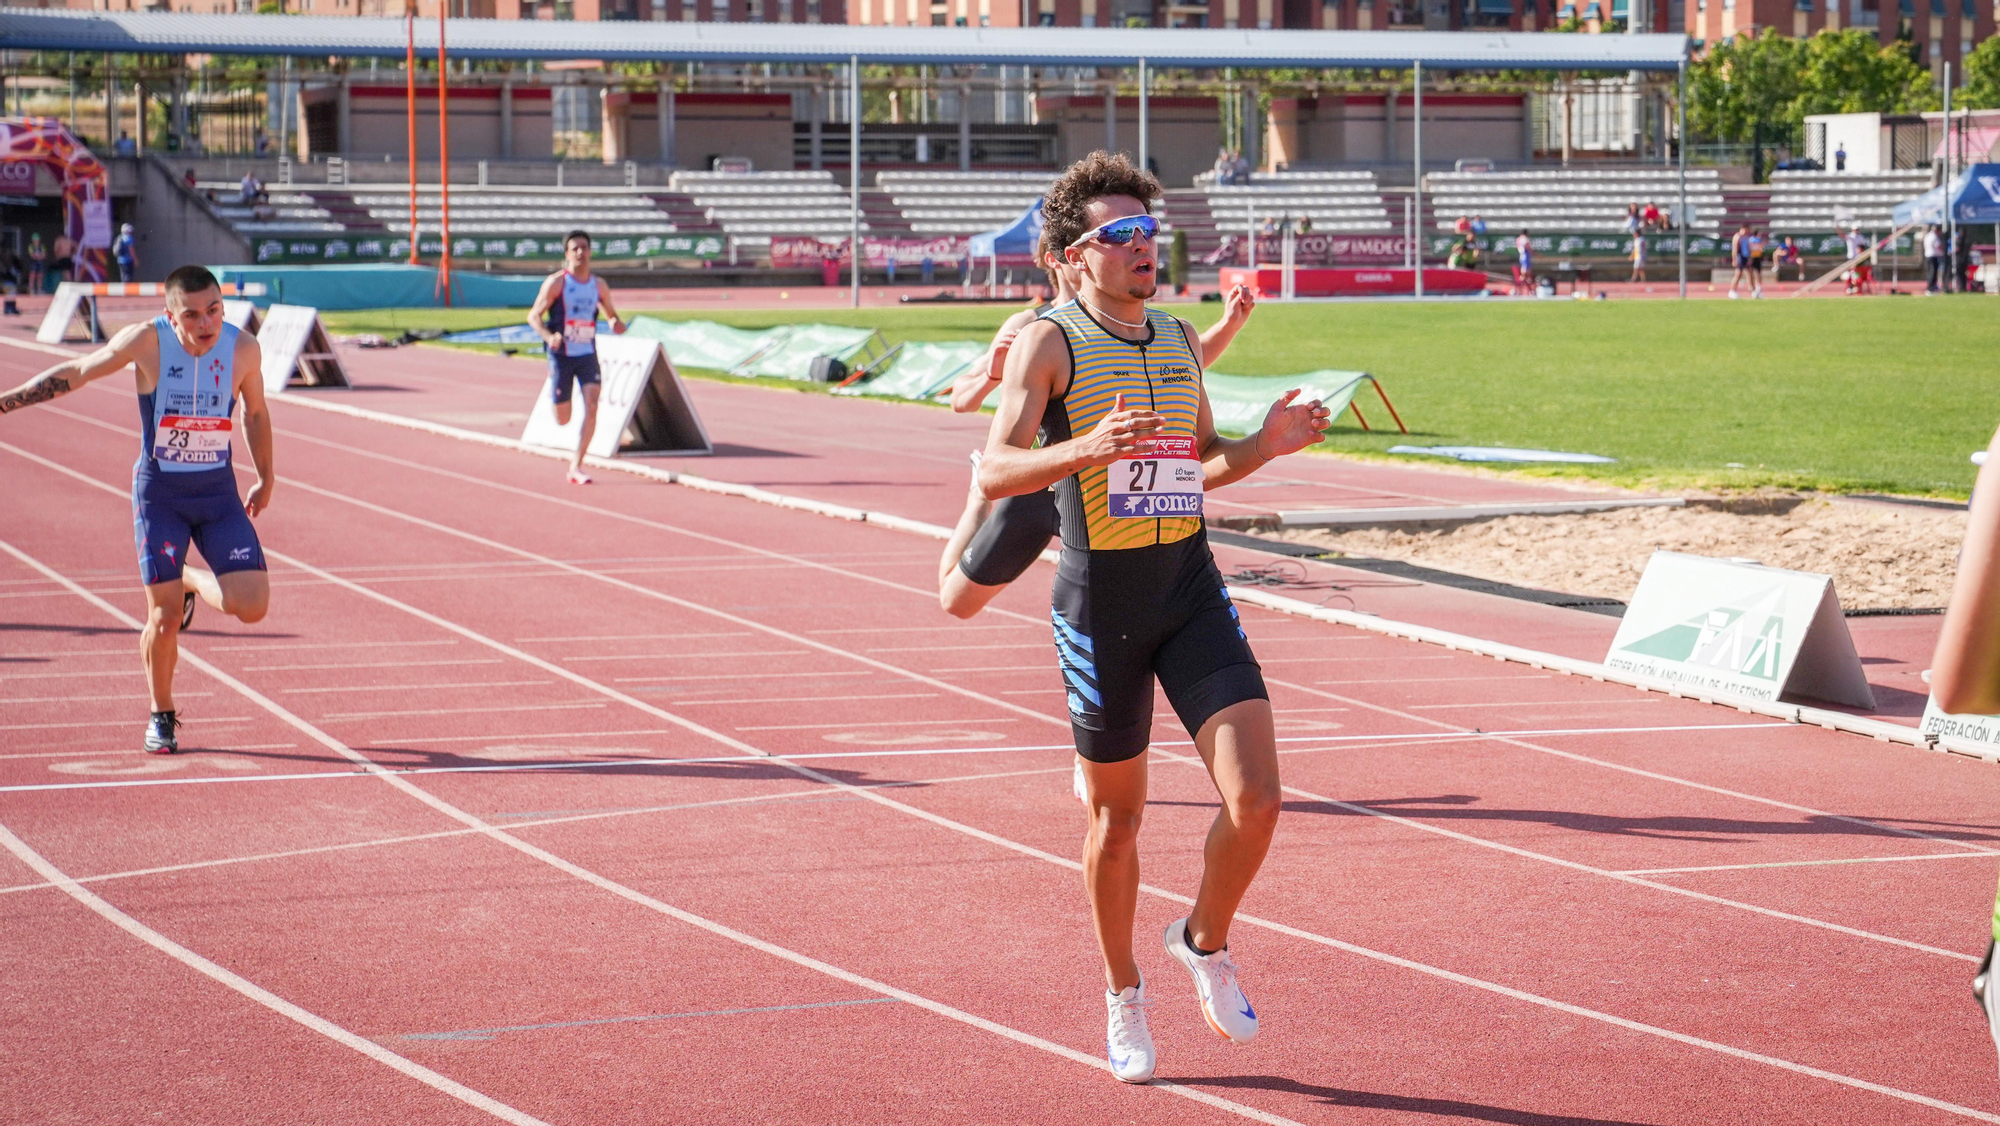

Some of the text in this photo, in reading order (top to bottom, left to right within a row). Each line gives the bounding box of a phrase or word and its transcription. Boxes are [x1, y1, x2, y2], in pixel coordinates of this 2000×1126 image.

[1162, 375, 1193, 384] MENORCA
[168, 429, 190, 448] 23
[1129, 460, 1158, 492] 27
[1925, 716, 1991, 742] FEDERACIÓN
